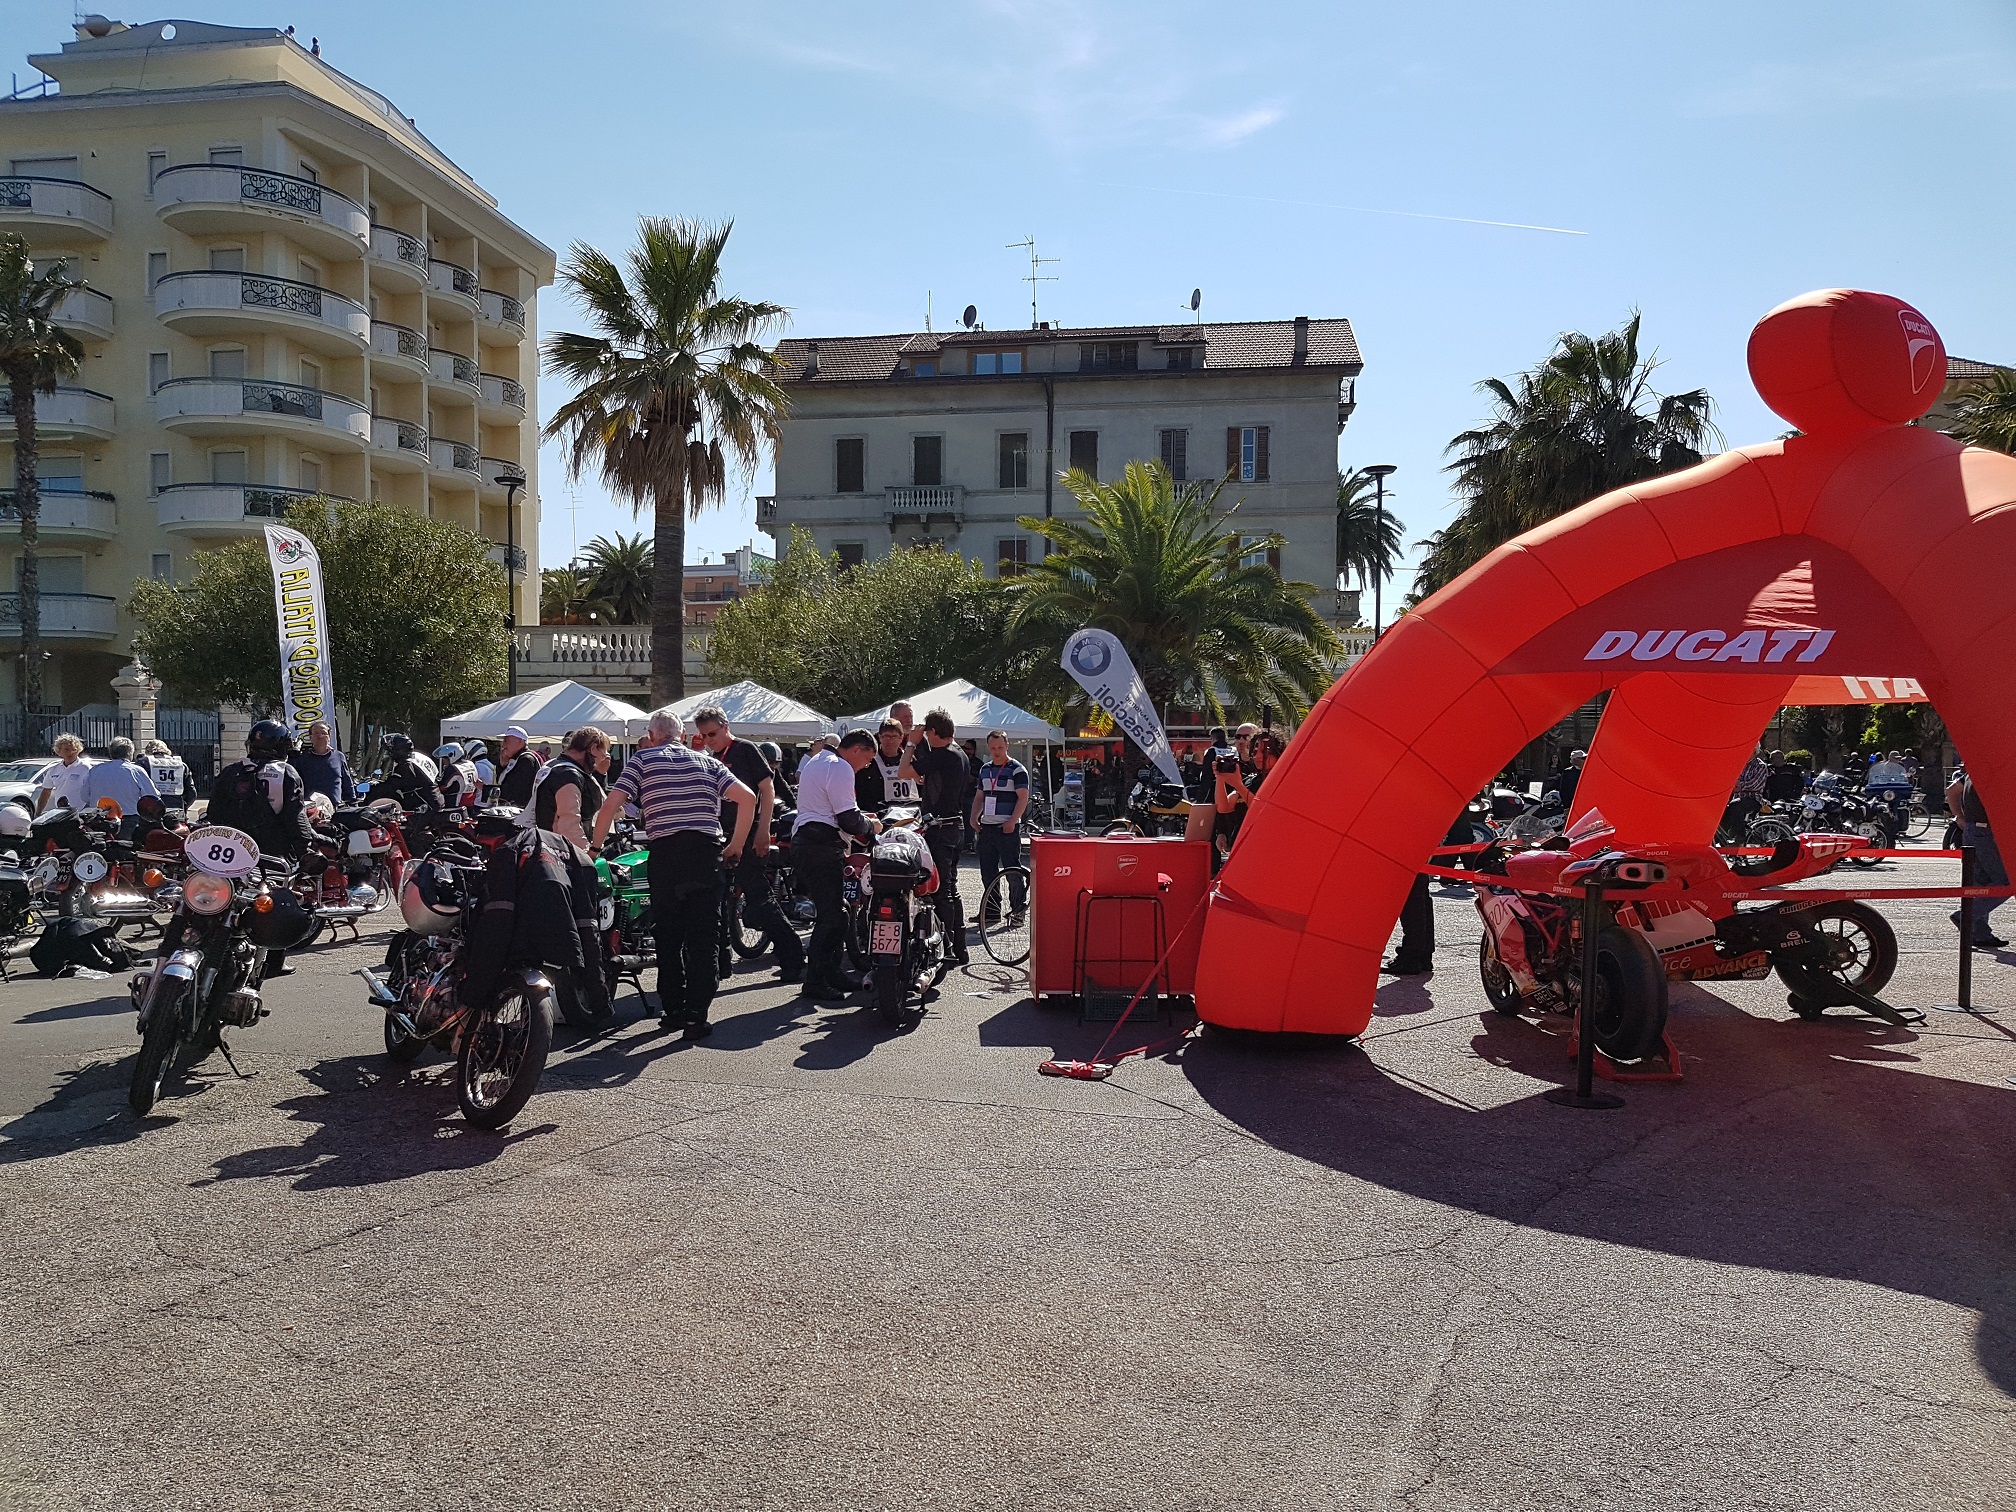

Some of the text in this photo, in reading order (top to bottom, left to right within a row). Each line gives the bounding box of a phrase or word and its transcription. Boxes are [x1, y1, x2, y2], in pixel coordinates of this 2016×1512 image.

[1904, 319, 1931, 336] DUCATI
[1583, 629, 1837, 663] DUCATI
[159, 769, 176, 782] 54
[893, 782, 910, 797] 30
[208, 844, 235, 864] 89
[87, 864, 93, 875] 8
[1054, 866, 1071, 876] 2D
[1552, 886, 1572, 894] DUCATI
[1780, 938, 1811, 949] BREIL
[1692, 954, 1767, 980] ADVANCE
